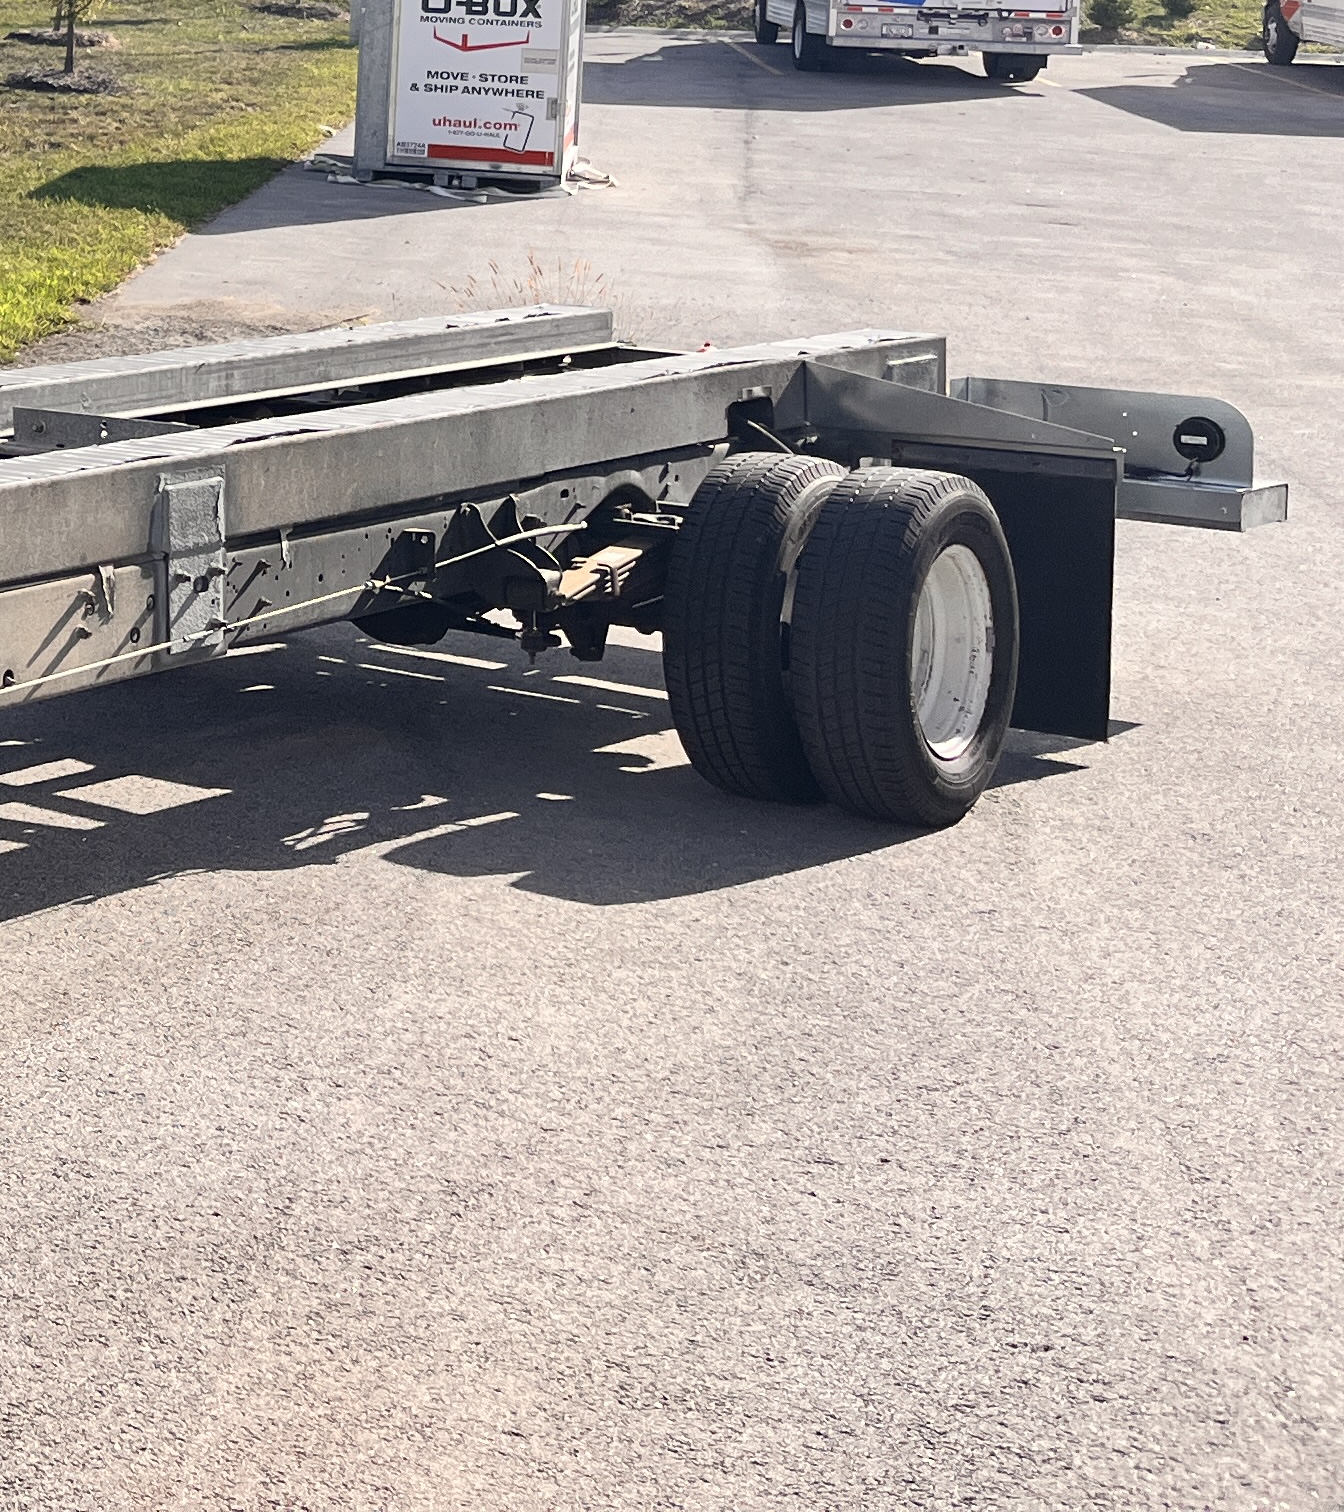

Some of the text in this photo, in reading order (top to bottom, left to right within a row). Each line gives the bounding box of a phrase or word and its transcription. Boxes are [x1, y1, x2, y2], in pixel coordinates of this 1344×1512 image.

[420, 15, 543, 29] MOVING CONTAINERS
[426, 70, 529, 85] MOVE STORE
[409, 83, 546, 100] & SHIP ANYWHERE
[431, 116, 519, 132] uhaul.com
